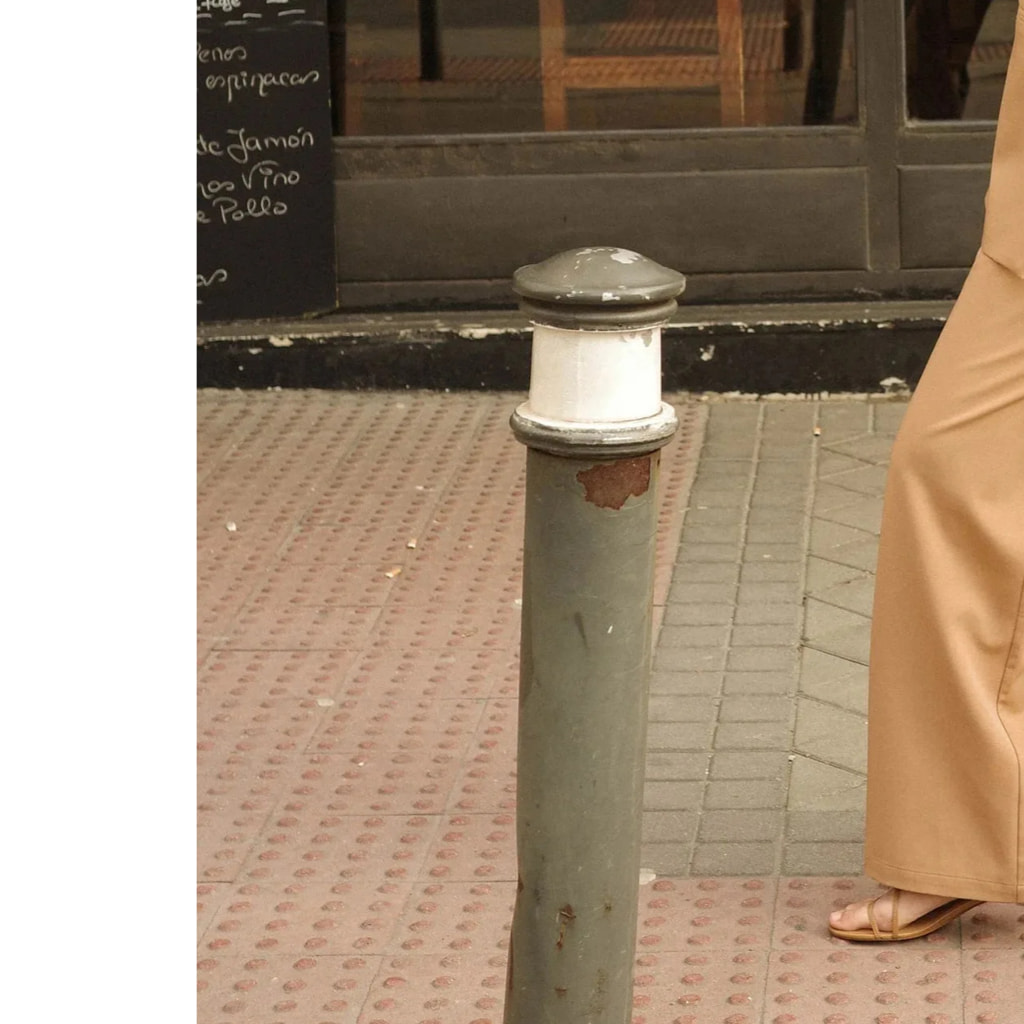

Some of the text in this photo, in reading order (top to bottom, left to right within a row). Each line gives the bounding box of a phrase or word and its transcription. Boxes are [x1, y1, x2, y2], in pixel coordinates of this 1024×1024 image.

[227, 127, 315, 164] Jamón
[242, 160, 300, 189] Vino
[212, 195, 288, 224] Pollo
